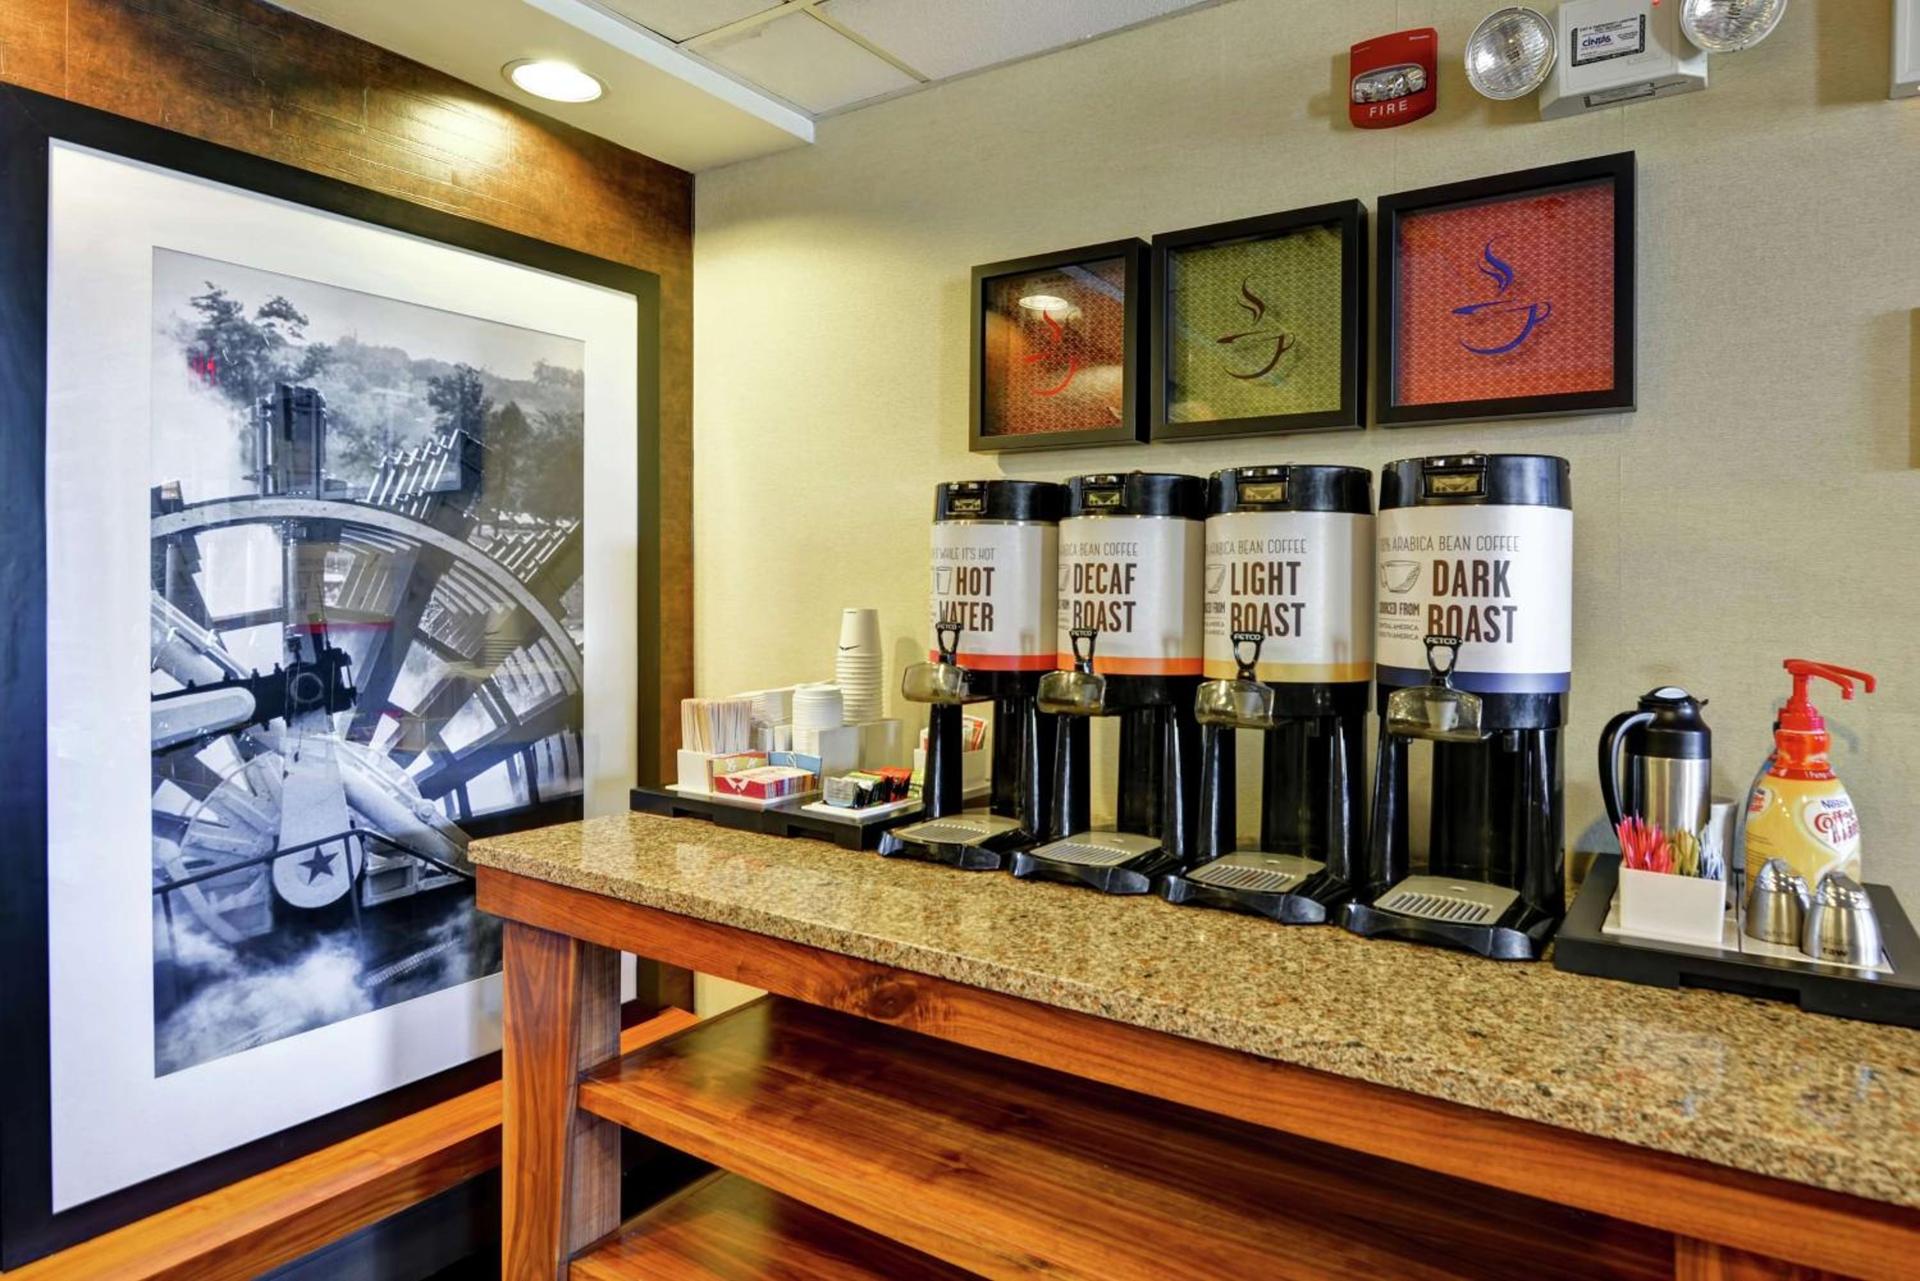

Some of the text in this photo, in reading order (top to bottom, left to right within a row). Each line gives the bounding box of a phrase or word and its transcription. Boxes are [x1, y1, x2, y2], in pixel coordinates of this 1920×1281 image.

[1369, 99, 1409, 118] FIRE
[978, 547, 996, 561] HOT
[1103, 541, 1139, 557] COFFEE
[1238, 539, 1264, 555] BEAN
[1267, 538, 1306, 553] COFFEE
[1391, 535, 1434, 552] ARABICA
[1439, 535, 1472, 551] BEAN
[1476, 535, 1520, 552] COFFEE
[956, 566, 996, 597] HOT
[1073, 562, 1138, 595] DECAF
[1231, 561, 1301, 596] LIGHT
[1432, 559, 1511, 598] DARK
[939, 600, 994, 632] WATER
[1073, 599, 1137, 633] ROAST
[1231, 602, 1306, 637] ROAST
[1428, 604, 1518, 643] ROAST
